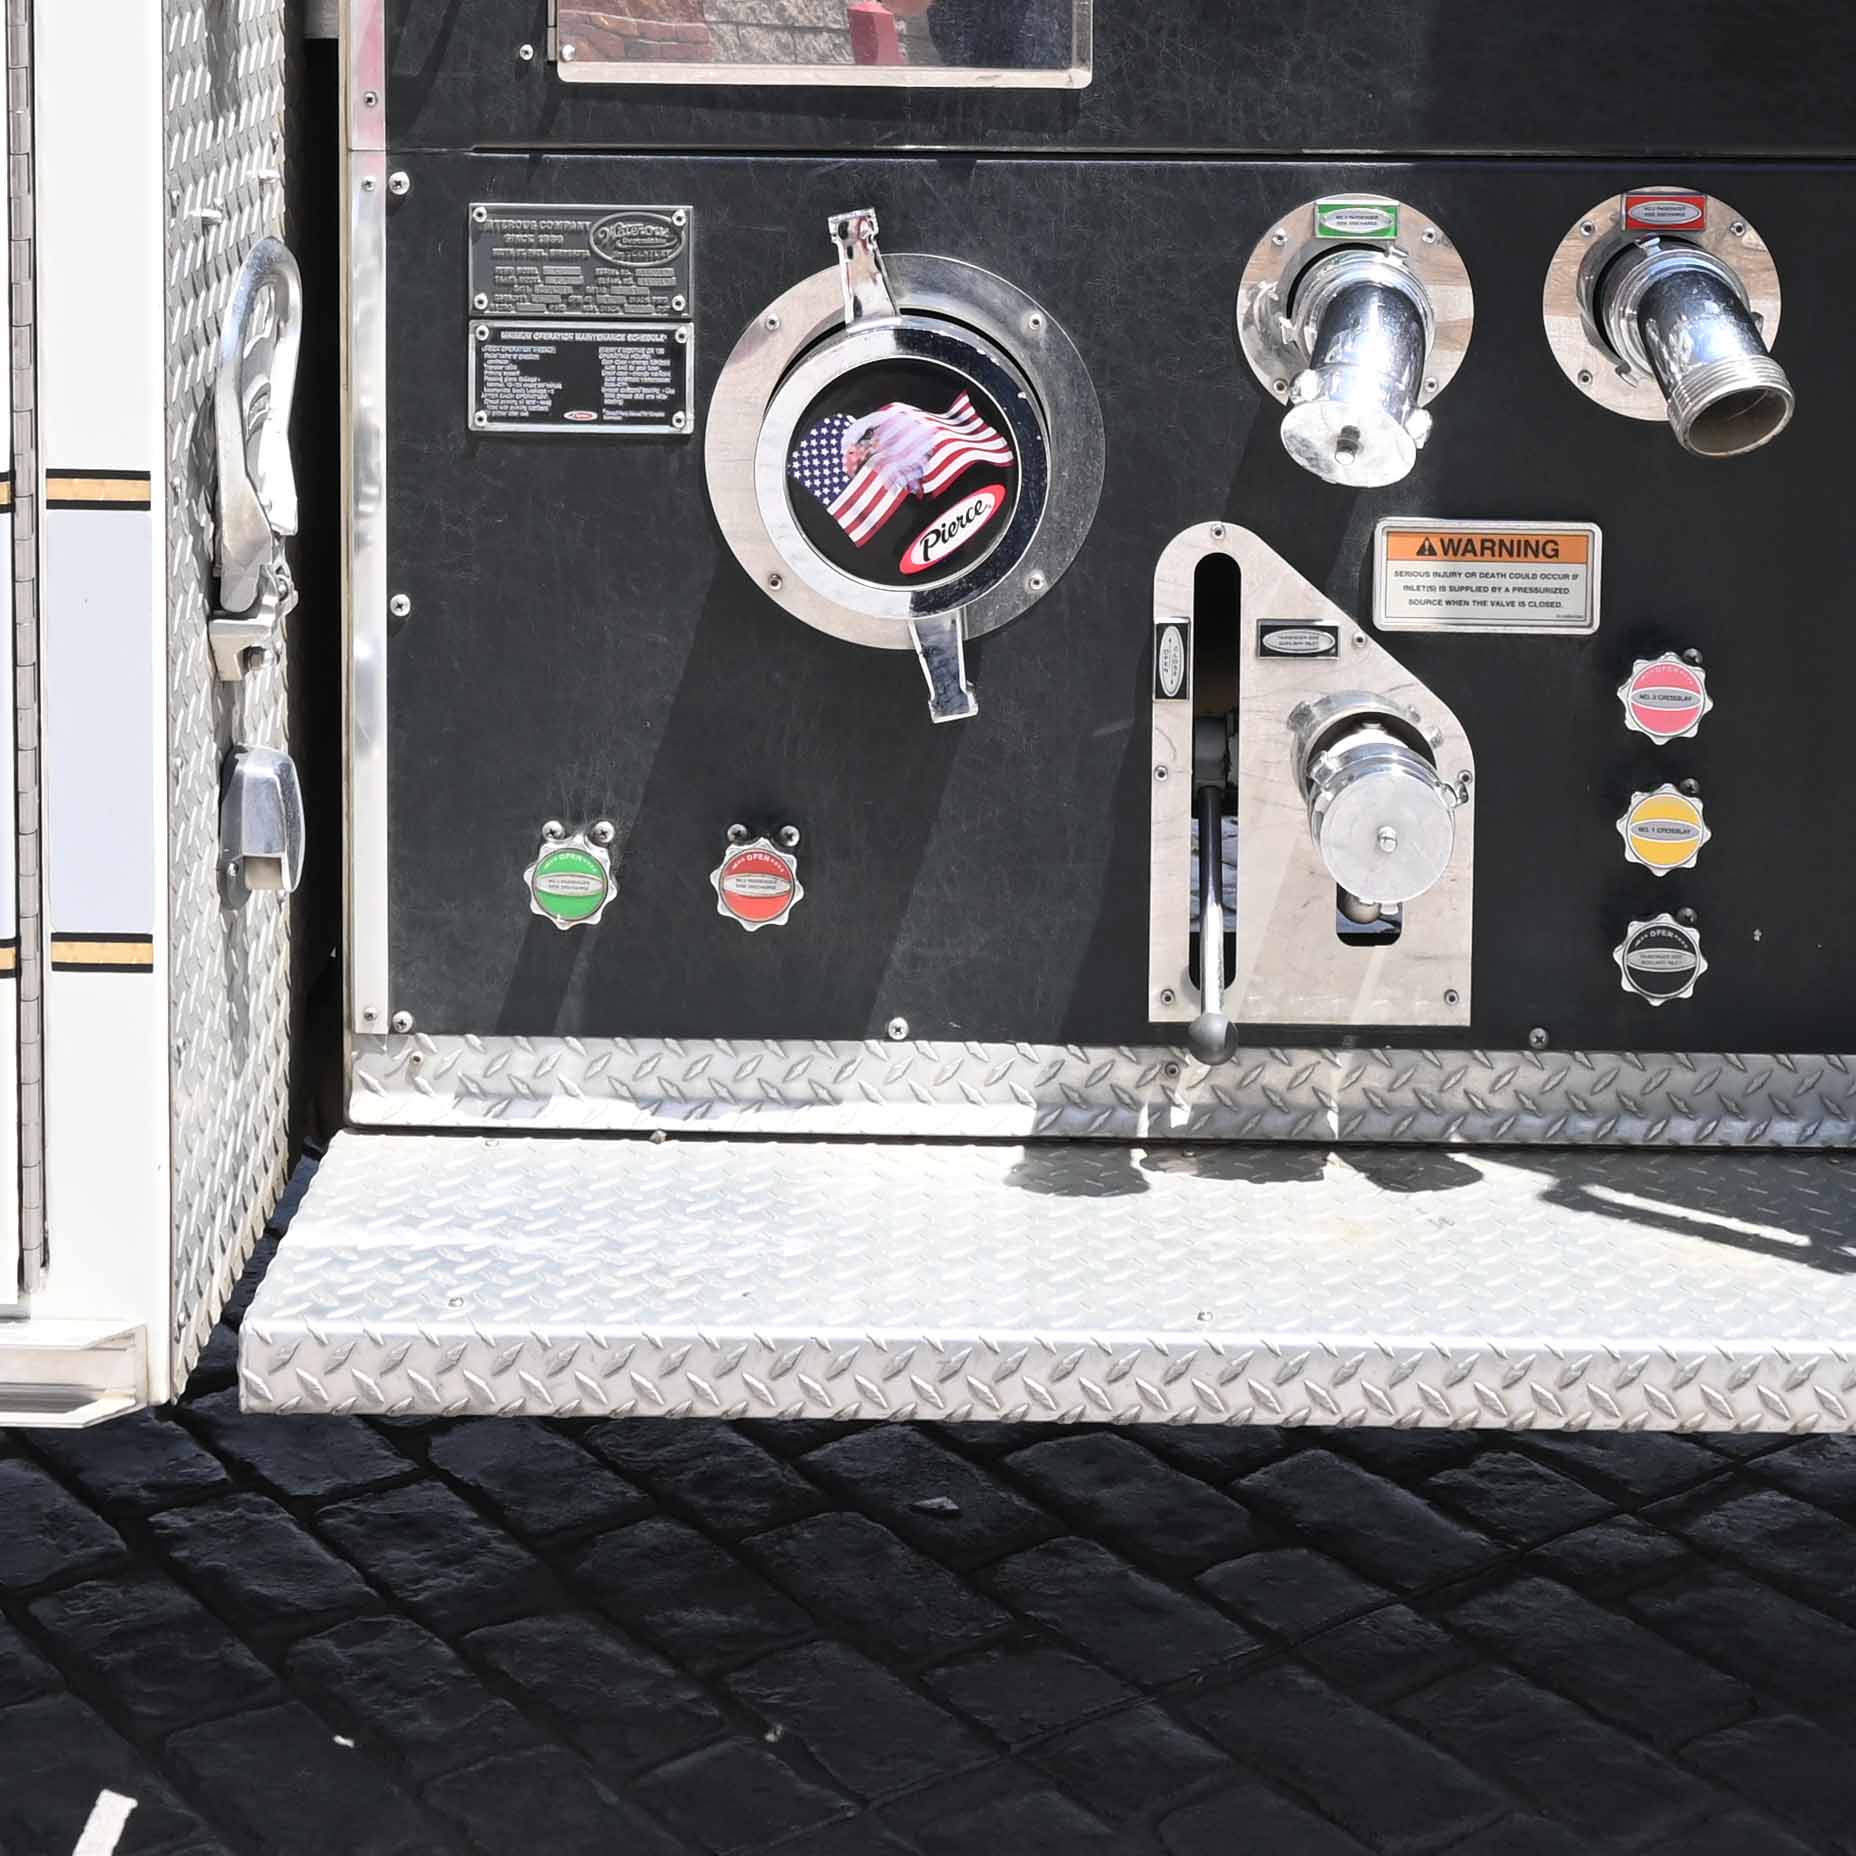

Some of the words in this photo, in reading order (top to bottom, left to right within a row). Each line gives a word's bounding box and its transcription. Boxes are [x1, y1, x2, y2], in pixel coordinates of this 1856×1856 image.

[919, 498, 987, 562] Pierce
[1439, 537, 1561, 560] WARNING
[1394, 570, 1431, 578] SERIOUS
[1432, 571, 1463, 579] INJURY
[1464, 571, 1477, 579] OR
[1478, 572, 1507, 580] DEATH
[1508, 572, 1538, 580] COULD
[1539, 573, 1570, 581] OCCUR
[1448, 585, 1490, 593] SUPPLIED
[1511, 586, 1570, 594] PRESSURIZED
[1408, 598, 1443, 607] SOURCE
[1444, 599, 1470, 607] WHEN
[1490, 600, 1516, 608] VALVE
[1649, 928, 1675, 939] OPEN
